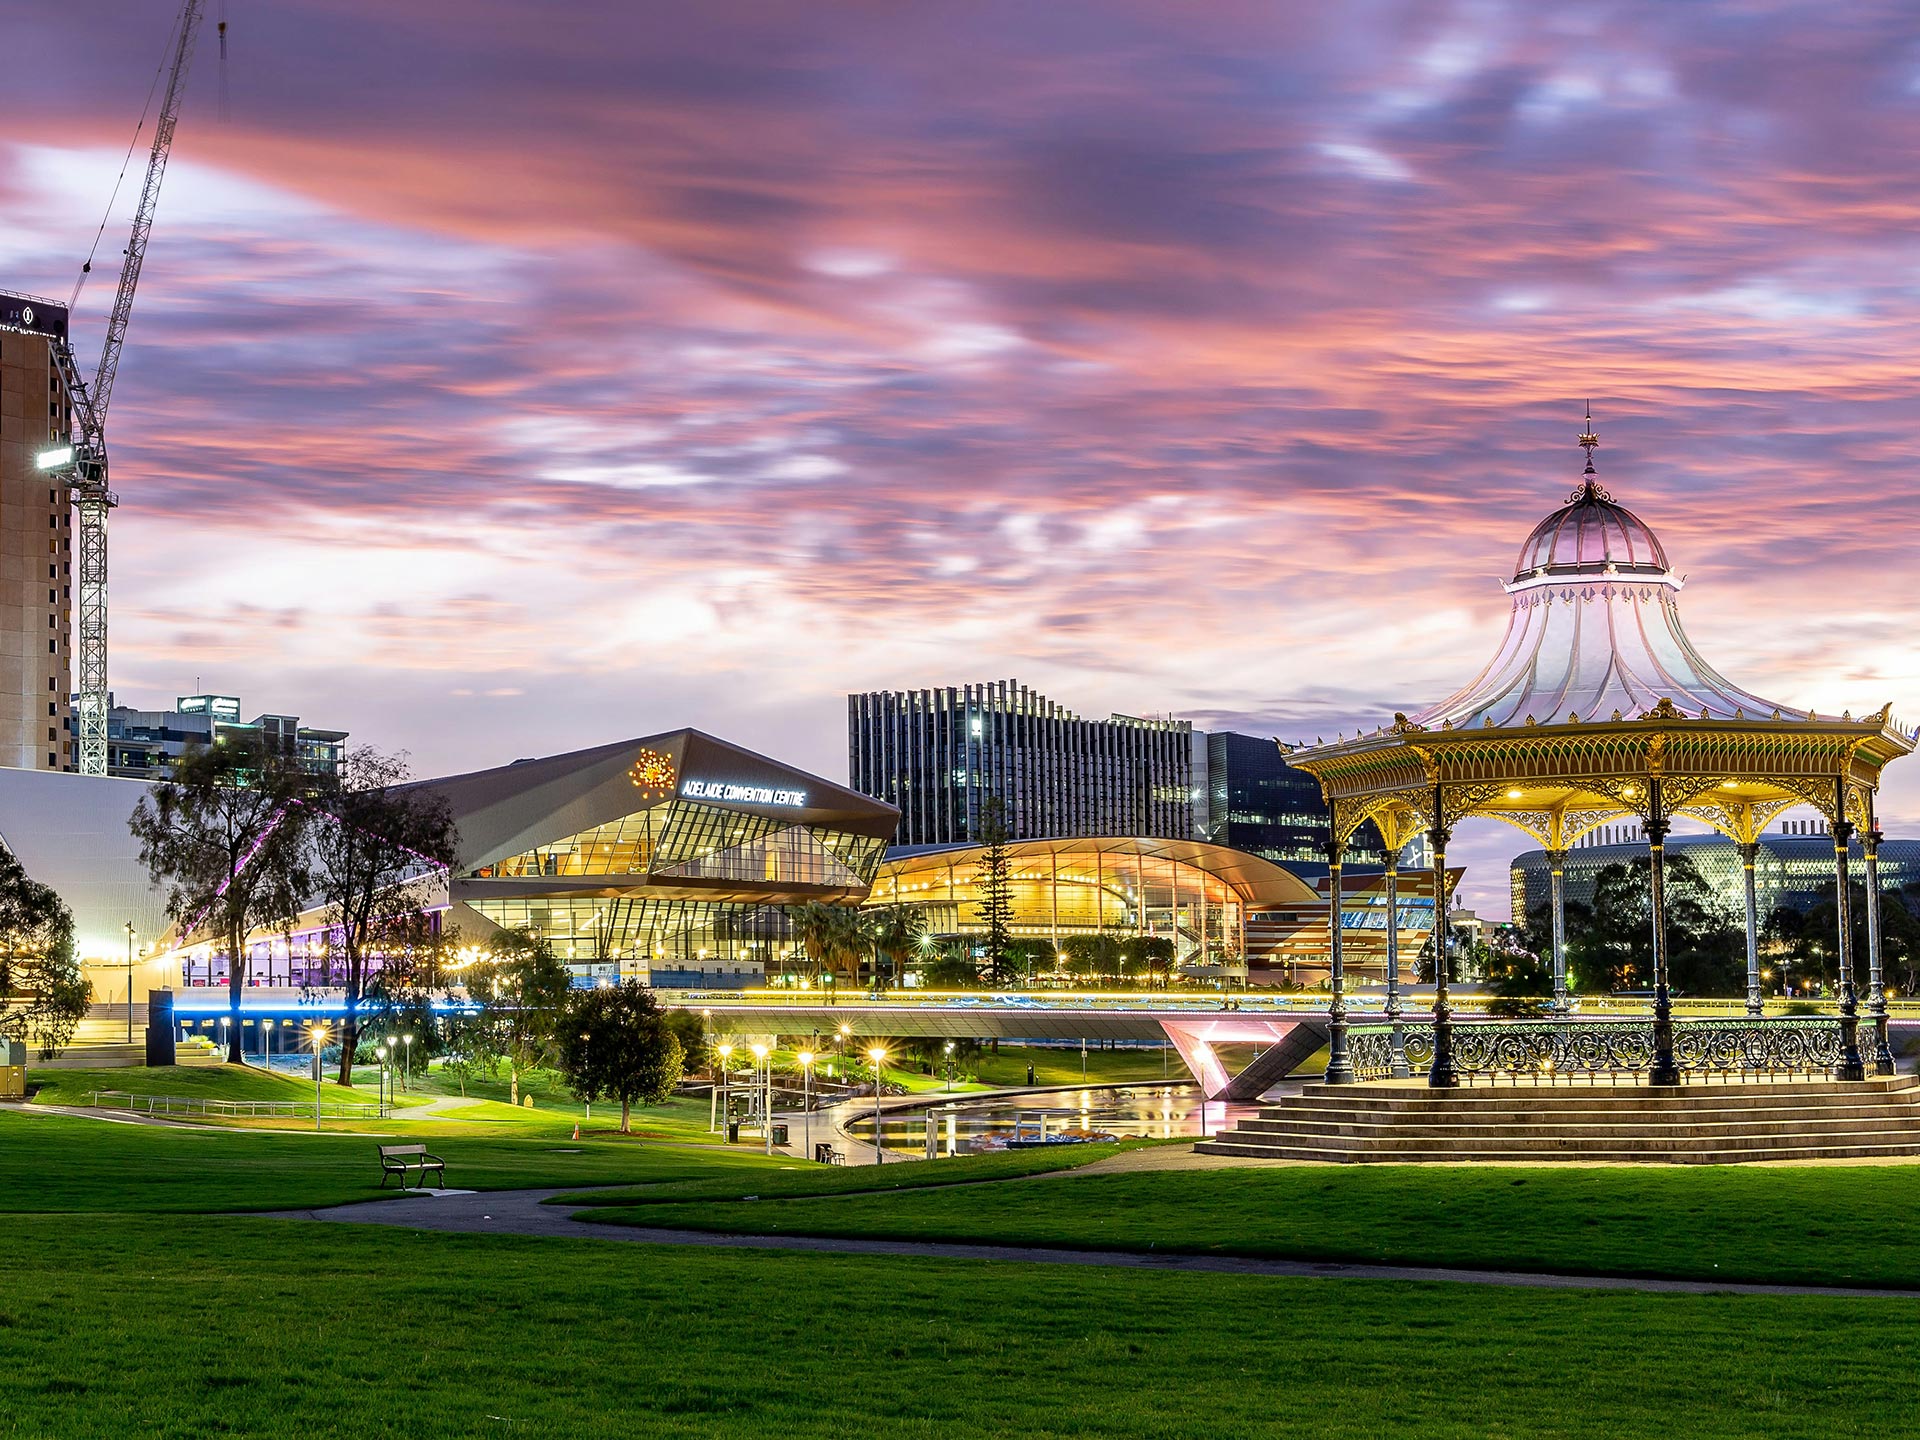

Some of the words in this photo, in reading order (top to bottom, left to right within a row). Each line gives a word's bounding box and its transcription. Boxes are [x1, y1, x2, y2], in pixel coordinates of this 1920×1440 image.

[682, 781, 725, 798] ADELAIDE
[724, 785, 775, 803] CONVENTION
[773, 790, 806, 806] CENTRE
